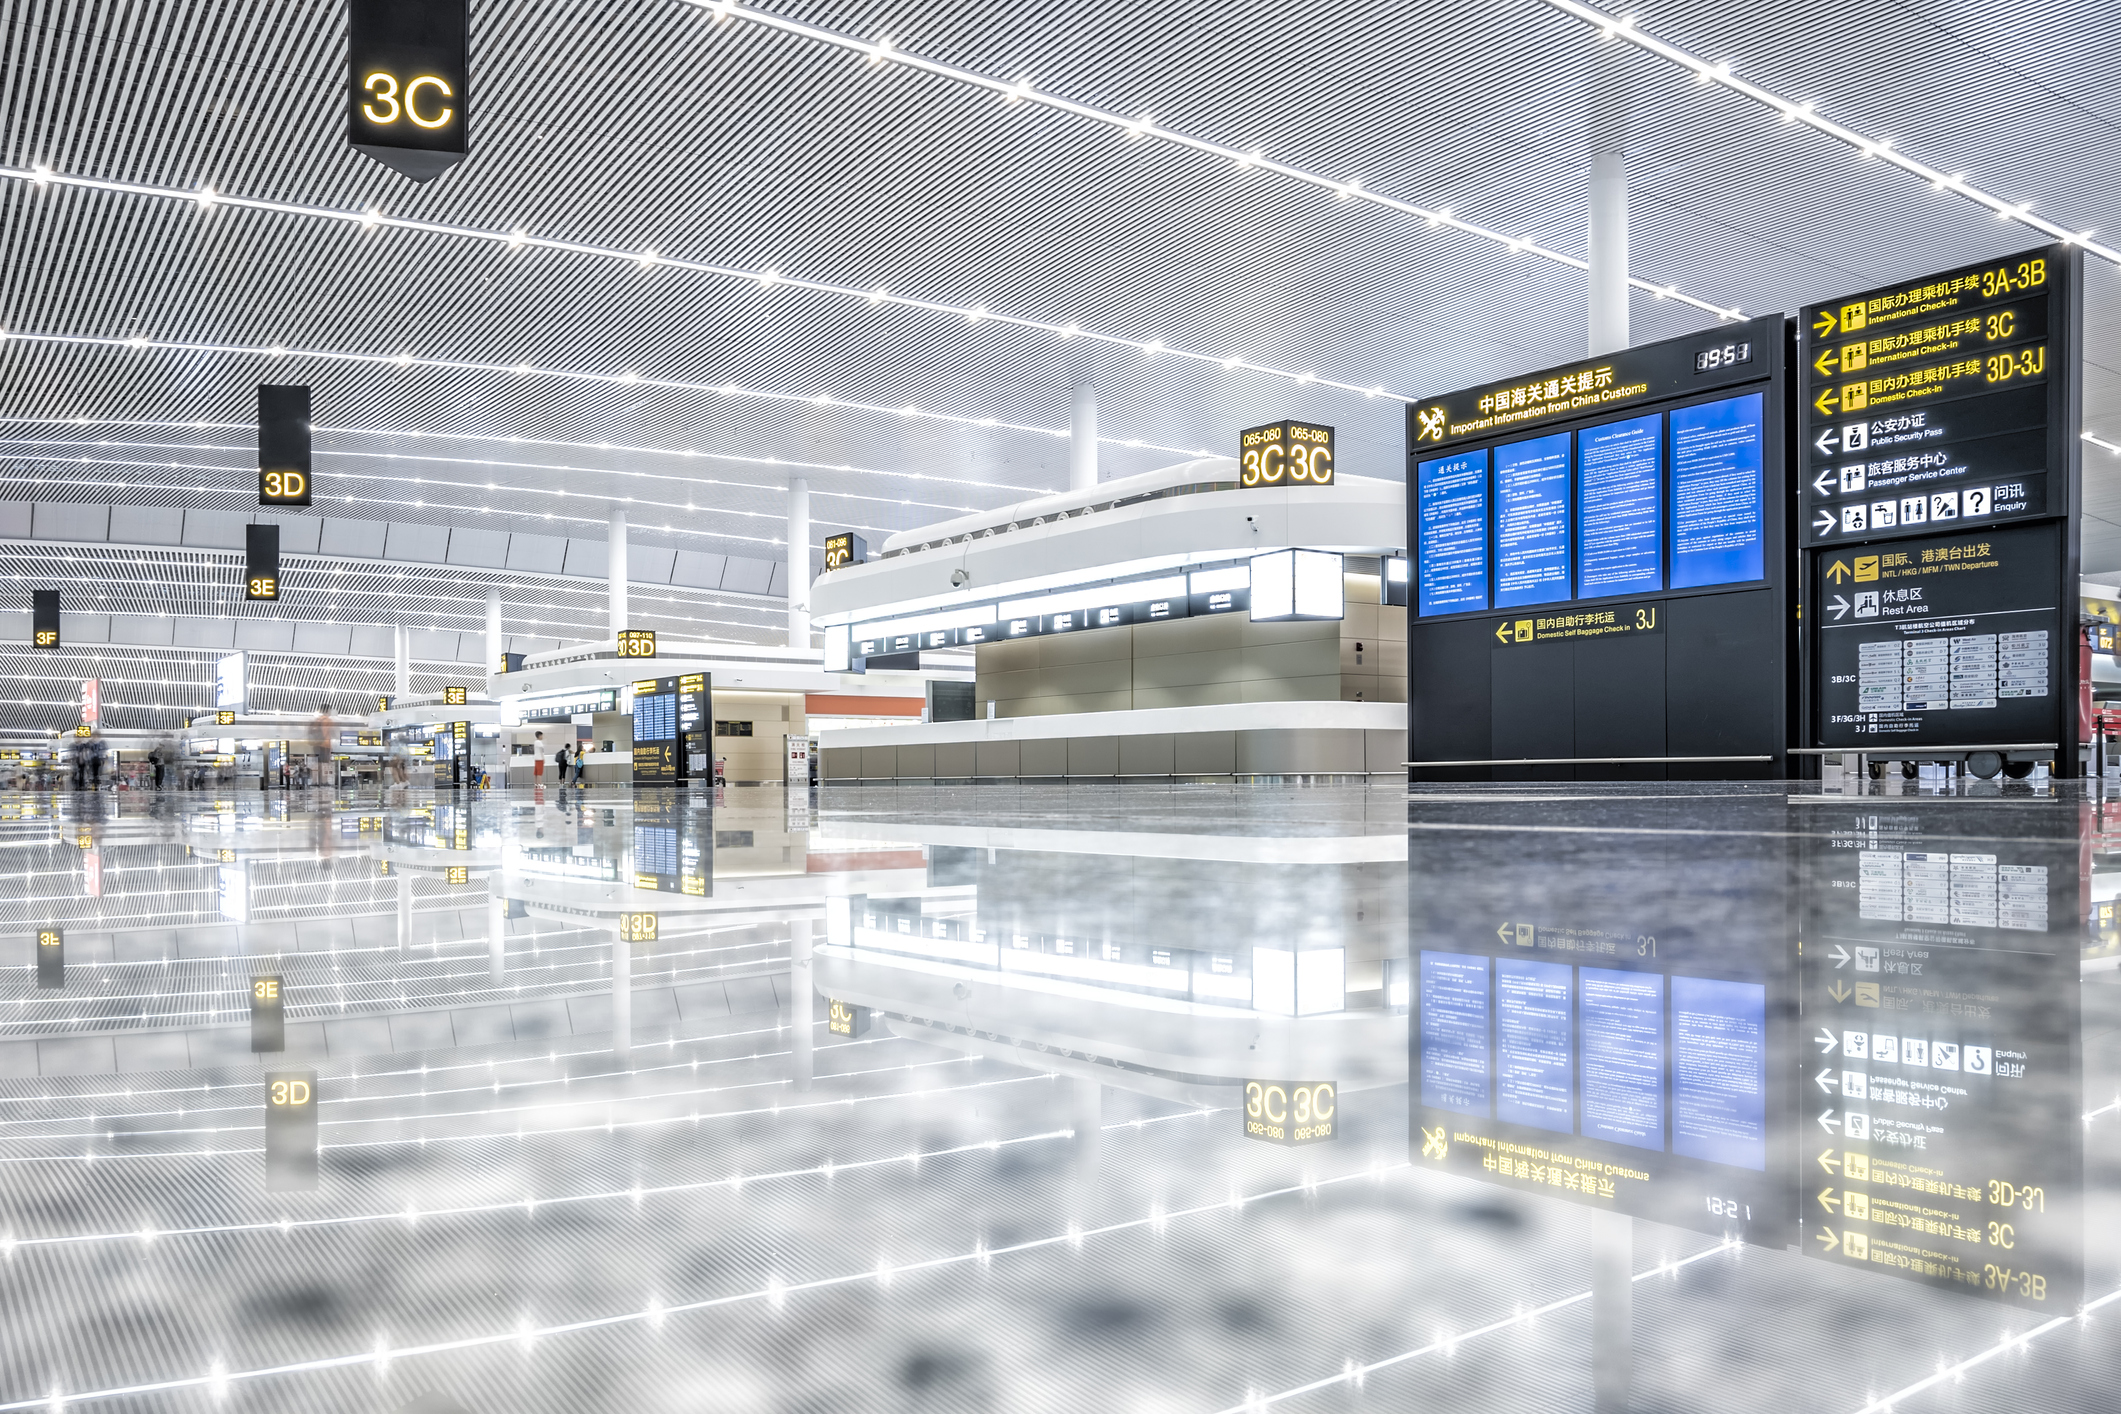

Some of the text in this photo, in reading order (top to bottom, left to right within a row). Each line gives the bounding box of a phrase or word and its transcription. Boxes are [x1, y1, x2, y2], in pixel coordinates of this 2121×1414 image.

[362, 72, 452, 128] 3C
[1982, 259, 2046, 298] 3A-3B
[1868, 274, 1979, 313] 国际办理乘机手续
[1868, 297, 1958, 325] International Check-in
[1869, 318, 1980, 354] 国际办理乘机手续
[1986, 312, 2014, 340] 3C
[1698, 342, 1748, 370] 19:51
[1870, 340, 1958, 365] International Check-in
[1986, 347, 2044, 382] 3D-3J
[1870, 360, 1980, 394] 国内办理乘机手续
[1480, 366, 1612, 416] 中国海关通关提示
[1870, 384, 1942, 405] Domestic Check-in
[1451, 382, 1648, 436] Important Information from China Customs
[1871, 413, 1926, 434] 公安办证
[1244, 428, 1281, 446] 065-080
[1290, 426, 1328, 444] 065-080
[1595, 428, 1644, 442] Customs Clearance Guide
[1871, 428, 1942, 446] Public Security Pass
[1243, 444, 1284, 486] 3C
[1290, 444, 1332, 483] 3C
[1438, 461, 1468, 474] 通关提示
[1868, 452, 1947, 476] 旅客服务中心
[264, 472, 304, 496] 3D
[1868, 465, 1966, 489] Passenger Service Center
[1994, 484, 2024, 500] 问讯
[1994, 500, 2026, 512] Enquiry
[1882, 559, 1998, 578] INTL HKG MFM TWN Departures
[250, 578, 274, 596] 3E
[1882, 588, 1922, 603] 休息区
[1636, 607, 1656, 630] 3J
[1882, 604, 1928, 616] Rest Area
[1536, 610, 1616, 632] 国内自助行李托运
[1537, 623, 1631, 640] Domestic Self Baggage Check in
[36, 632, 56, 644] 3F
[628, 639, 654, 656] 3D
[1831, 675, 1856, 683] 3B/3C
[448, 692, 464, 704] 3E
[219, 714, 234, 724] 3F
